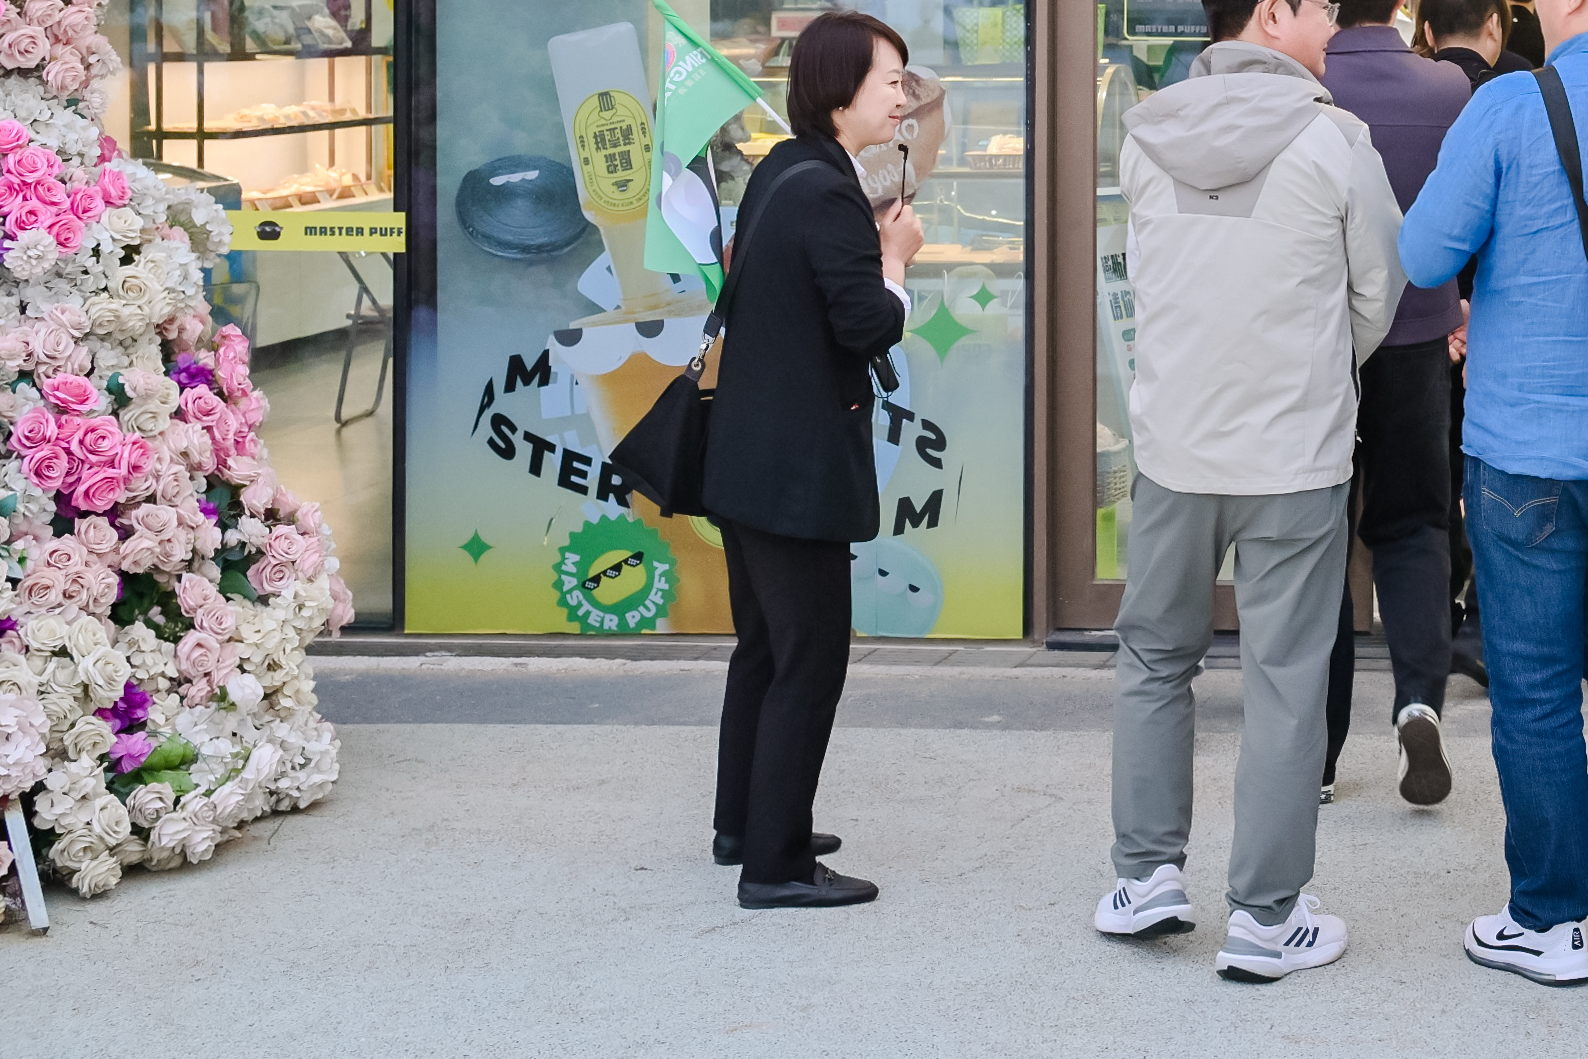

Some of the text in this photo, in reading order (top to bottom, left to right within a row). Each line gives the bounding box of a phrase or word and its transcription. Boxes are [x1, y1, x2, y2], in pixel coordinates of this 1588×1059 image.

[304, 225, 364, 237] MASTER
[560, 552, 670, 631] MASTER PUFFY
[1573, 931, 1582, 947] AIR
